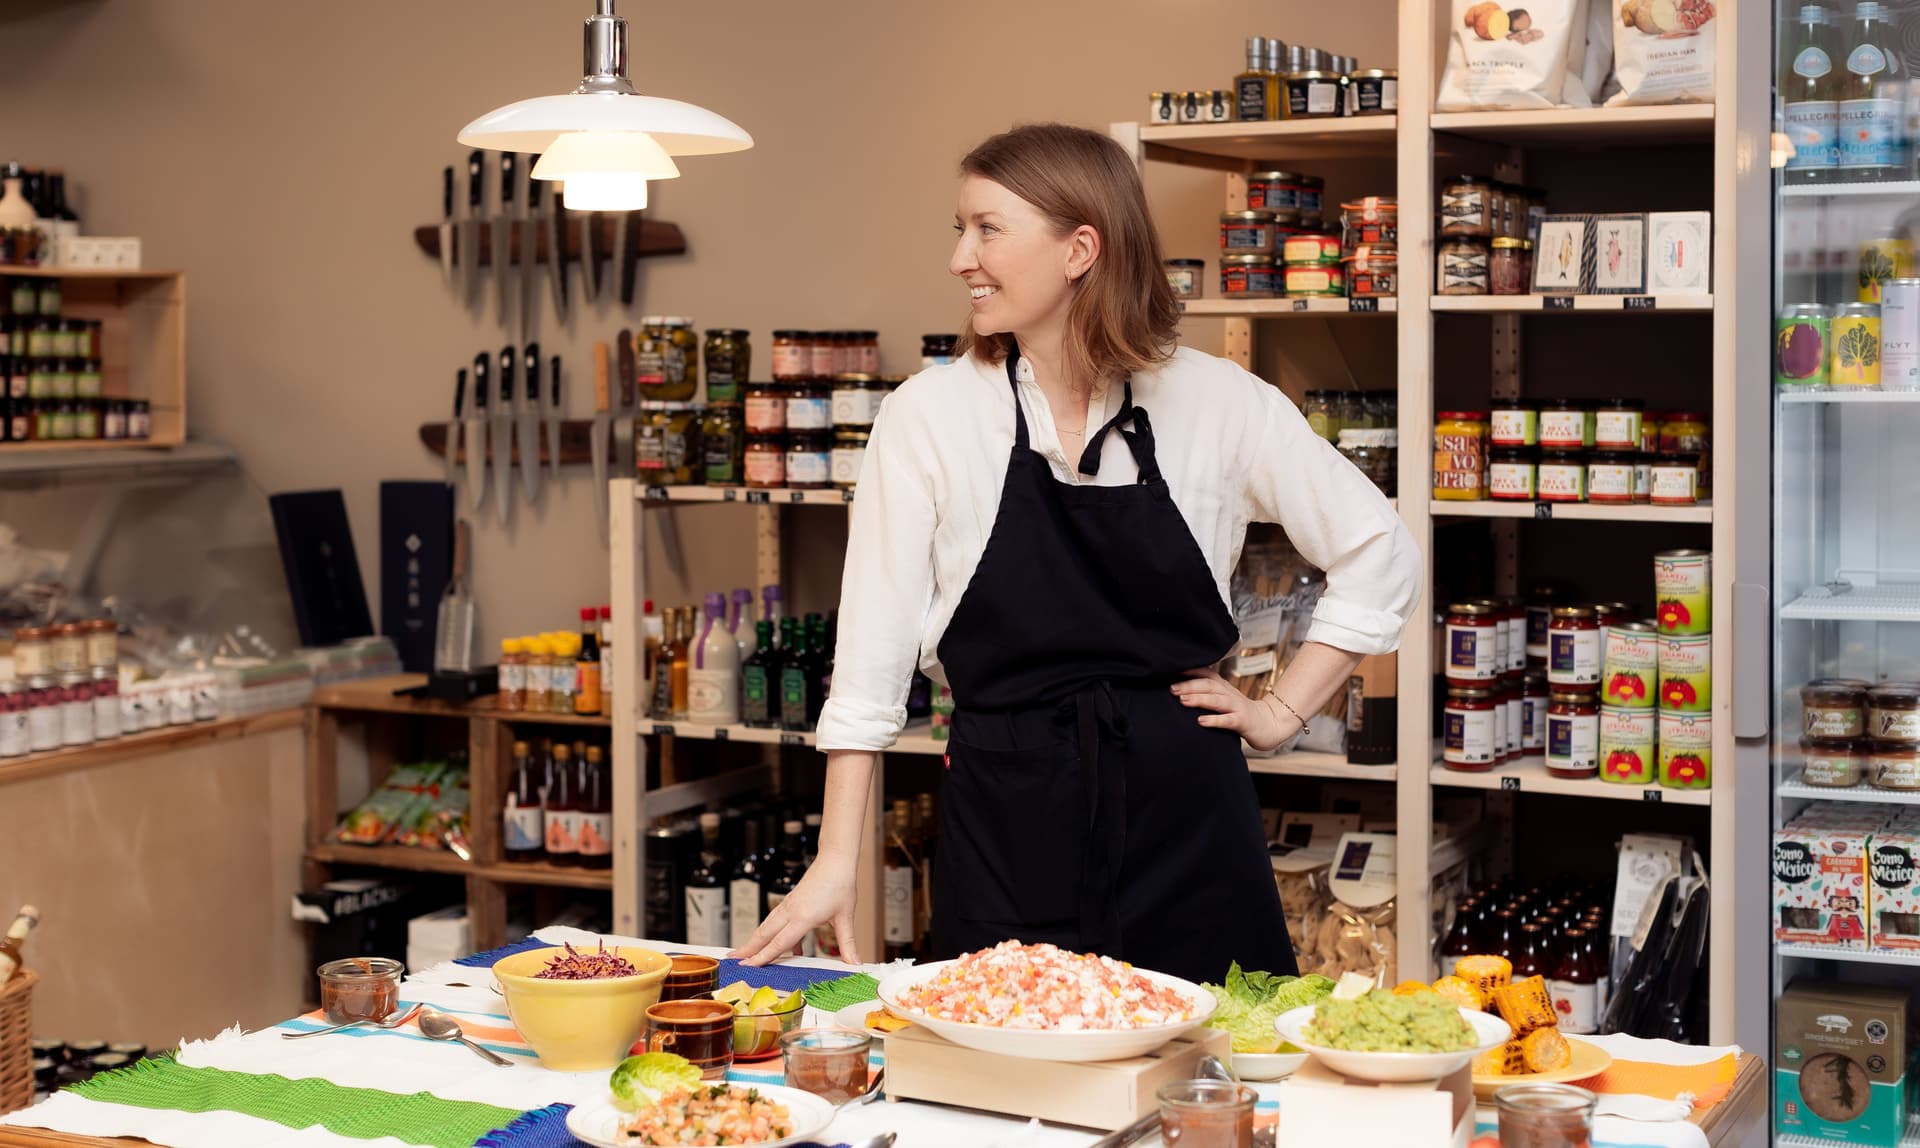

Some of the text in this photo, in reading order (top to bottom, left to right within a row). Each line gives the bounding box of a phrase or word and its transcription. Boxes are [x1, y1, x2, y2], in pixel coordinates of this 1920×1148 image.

[1774, 847, 1804, 861] Como
[1871, 851, 1904, 865] Como
[1774, 862, 1815, 878] México
[1871, 866, 1914, 882] México
